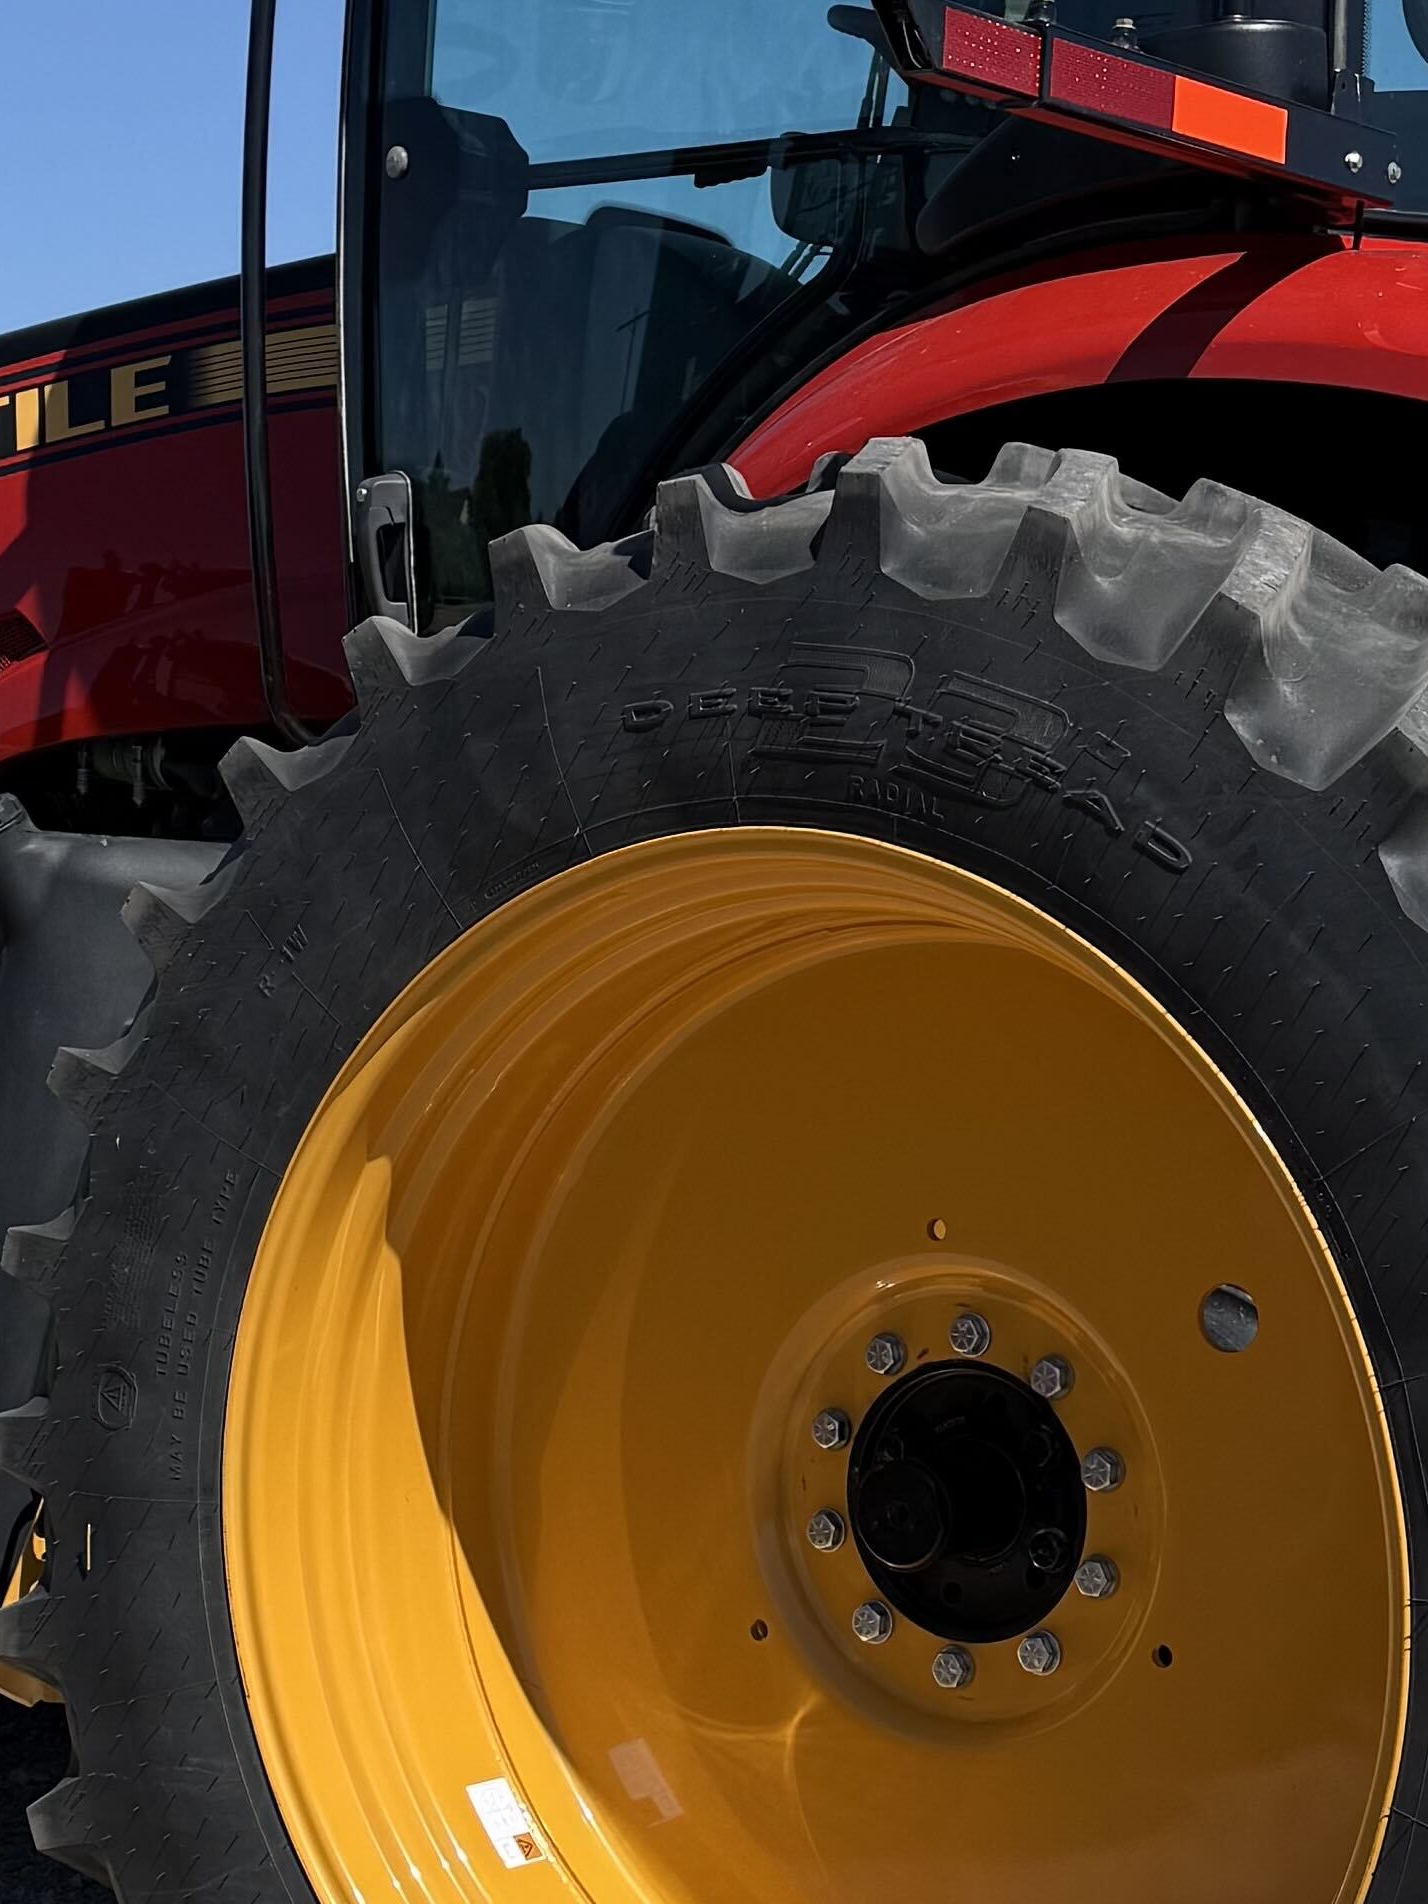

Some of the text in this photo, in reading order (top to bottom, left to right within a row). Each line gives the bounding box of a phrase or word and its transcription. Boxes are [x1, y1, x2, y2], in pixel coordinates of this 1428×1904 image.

[847, 774, 945, 823] RADIAL
[156, 1251, 188, 1378] TUBELESS
[169, 1167, 239, 1481] MAY BE USED TUBE TYPE
